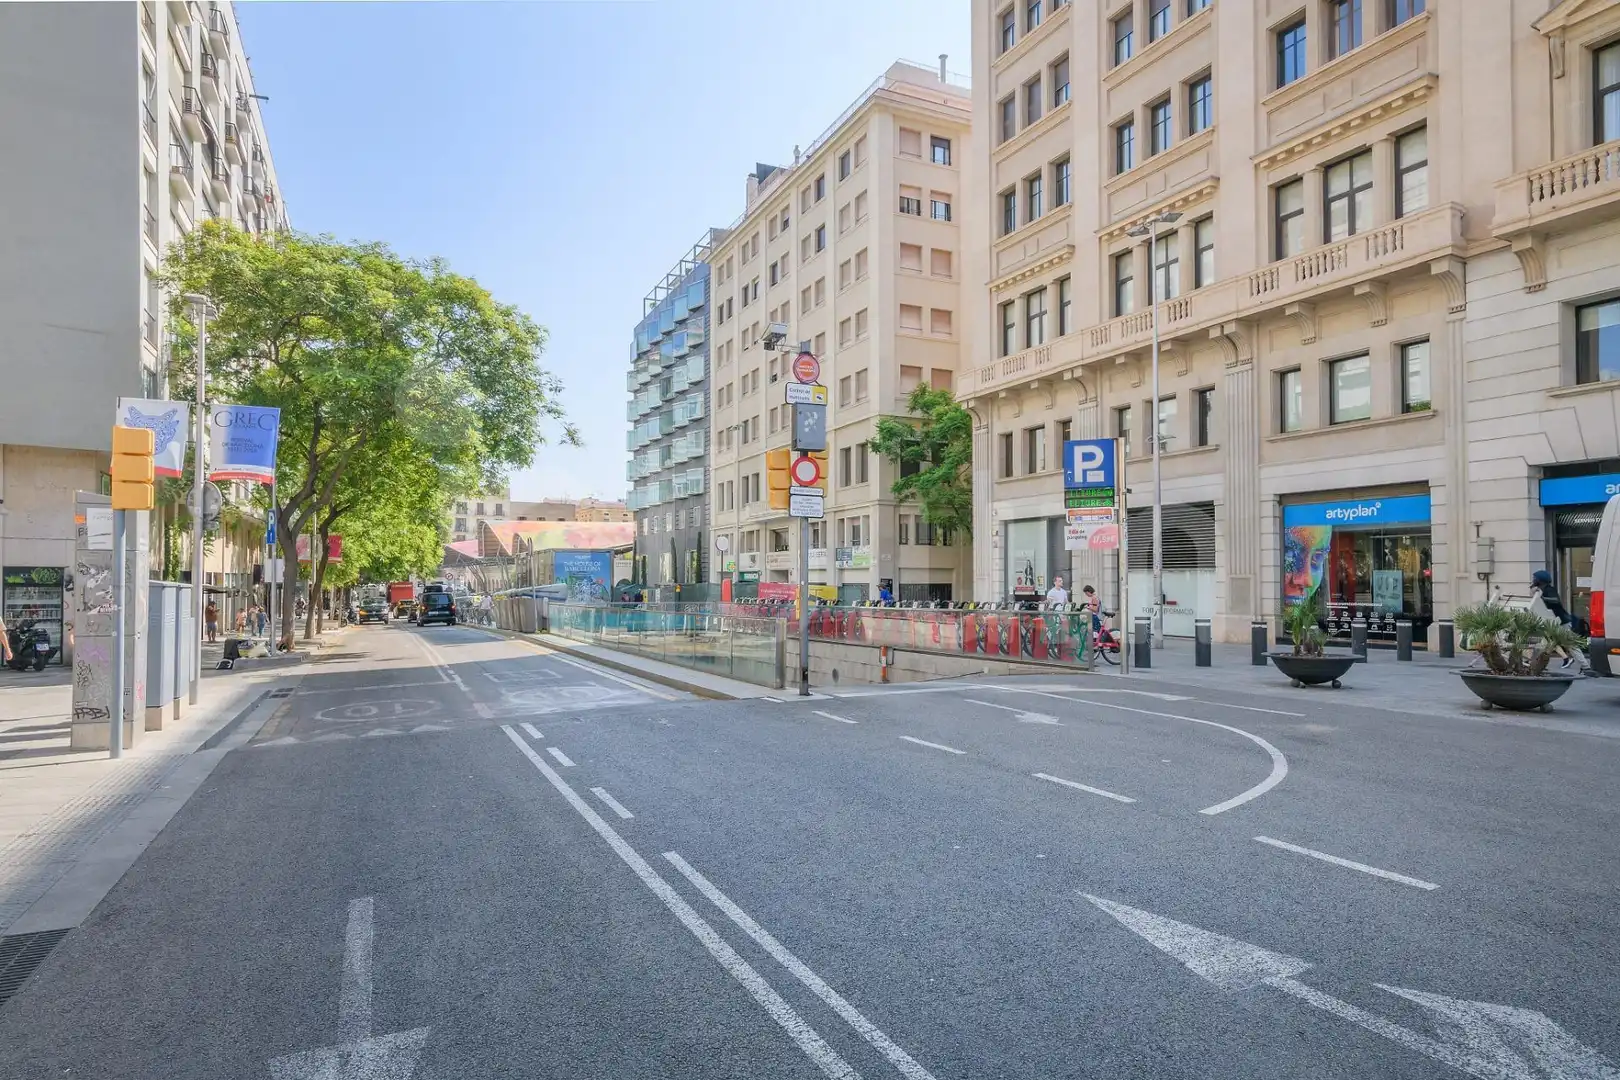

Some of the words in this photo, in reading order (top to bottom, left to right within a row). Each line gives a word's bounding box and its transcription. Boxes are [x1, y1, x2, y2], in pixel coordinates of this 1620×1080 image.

[214, 410, 277, 431] GREC
[1074, 445, 1104, 482] P
[1325, 504, 1377, 521] artyplan
